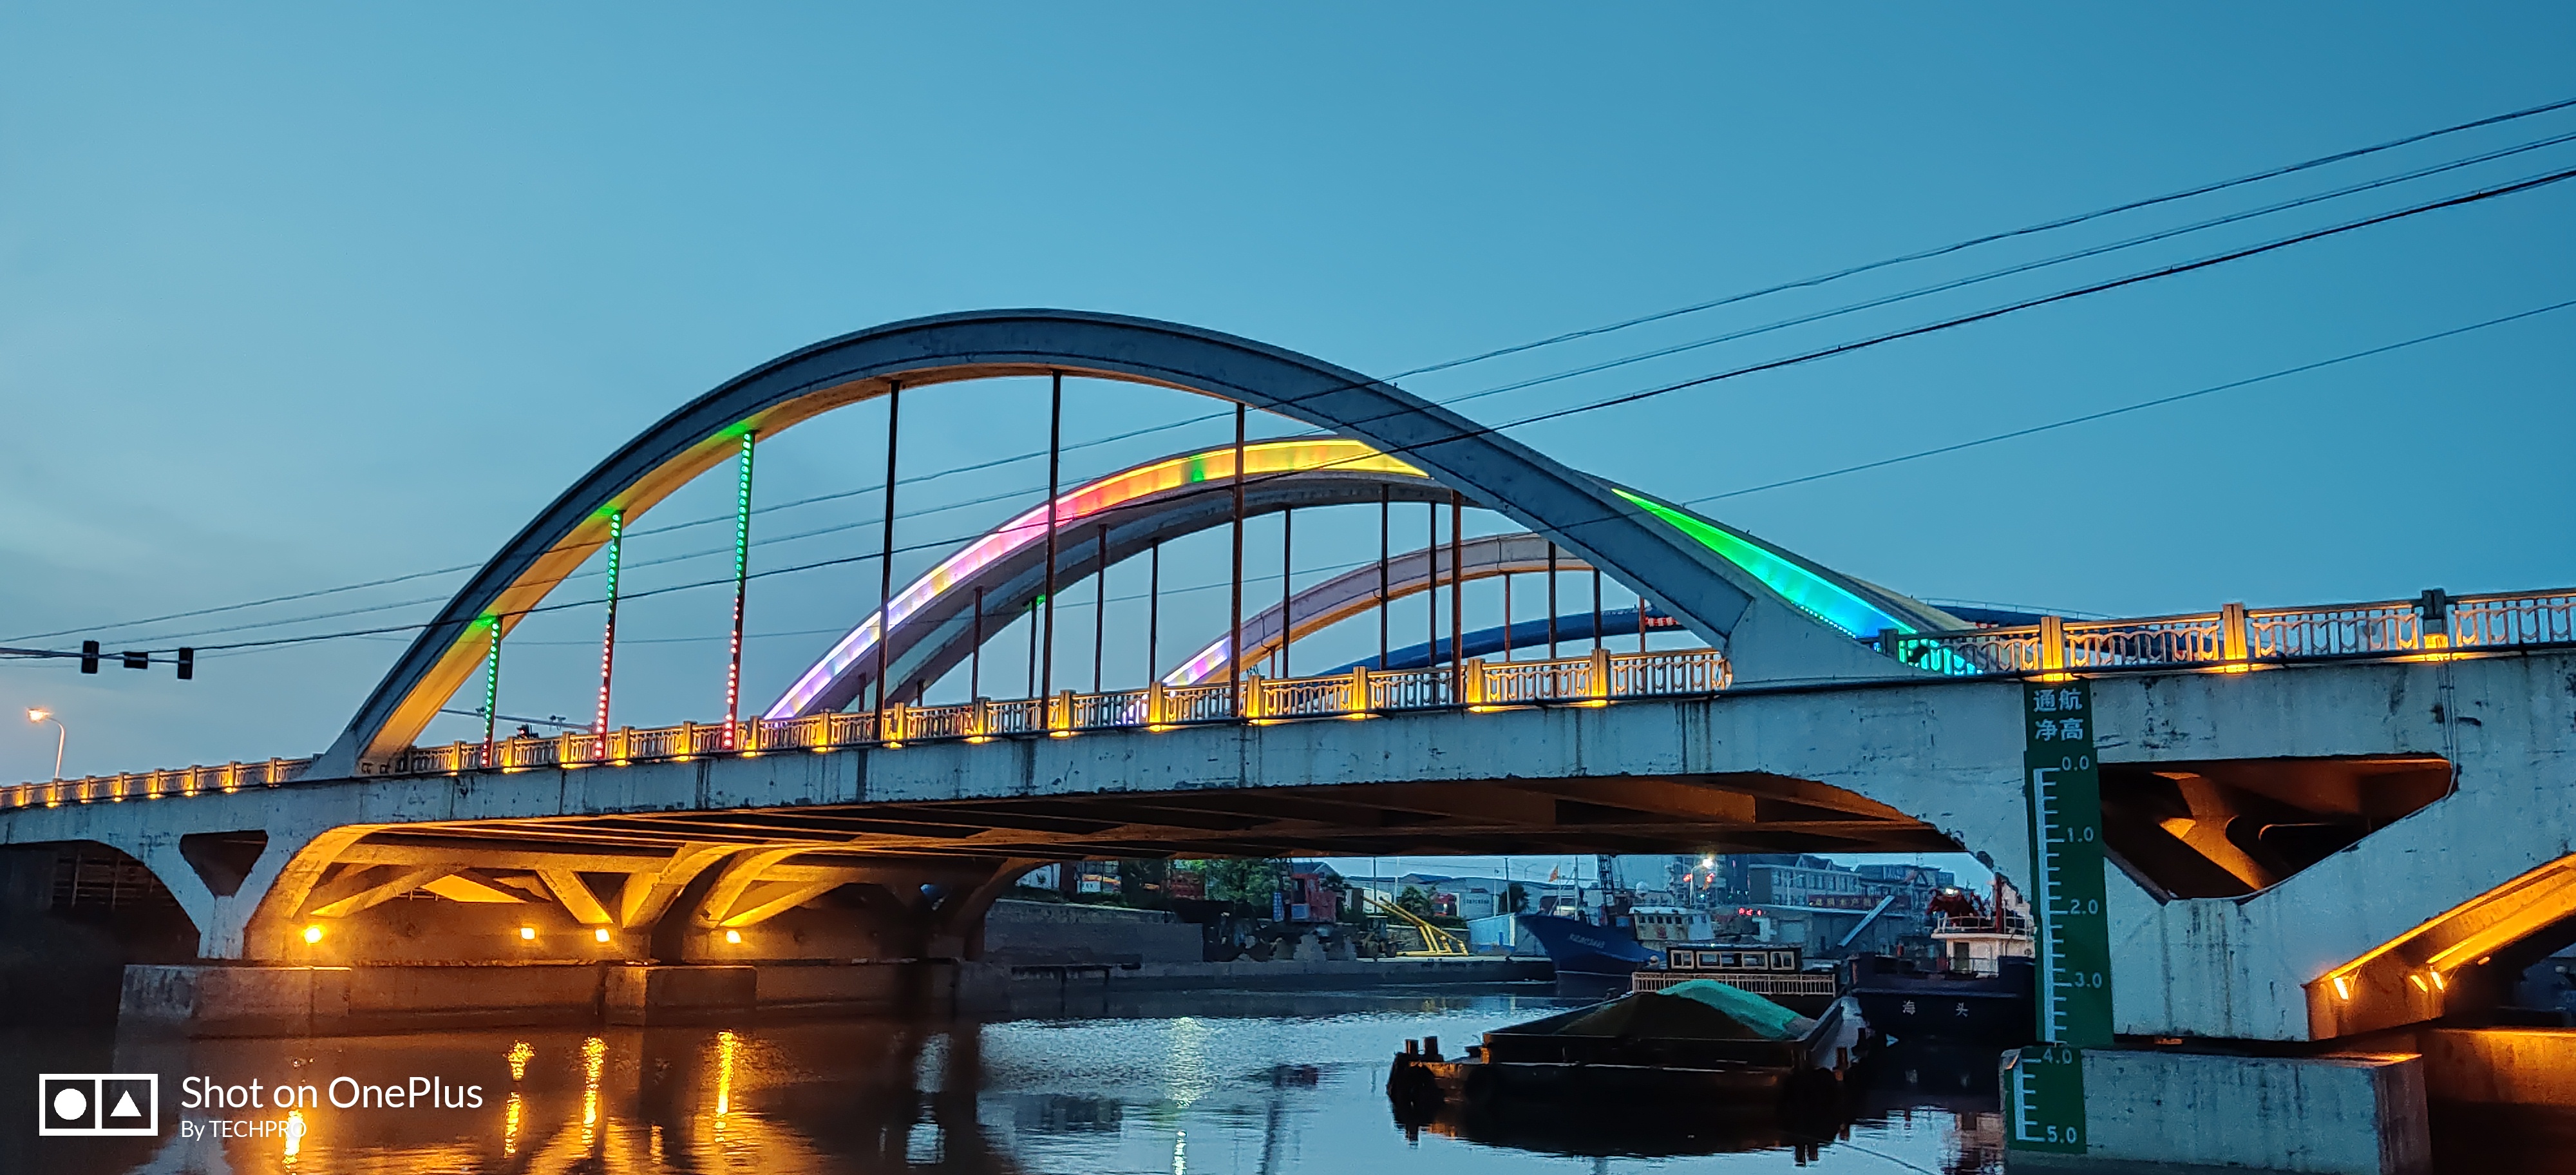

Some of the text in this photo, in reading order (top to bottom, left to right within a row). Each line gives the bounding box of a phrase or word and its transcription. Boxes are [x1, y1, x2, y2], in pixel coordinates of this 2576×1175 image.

[2033, 688, 2083, 712] 通航
[2035, 718, 2083, 741] 净高
[2062, 755, 2089, 771] 0.0
[2067, 826, 2094, 843] 1.0
[2070, 899, 2098, 915] 2.0
[2074, 972, 2102, 988] 3.0
[2042, 1048, 2072, 1064] 4.0
[2047, 1125, 2077, 1143] 5.0
